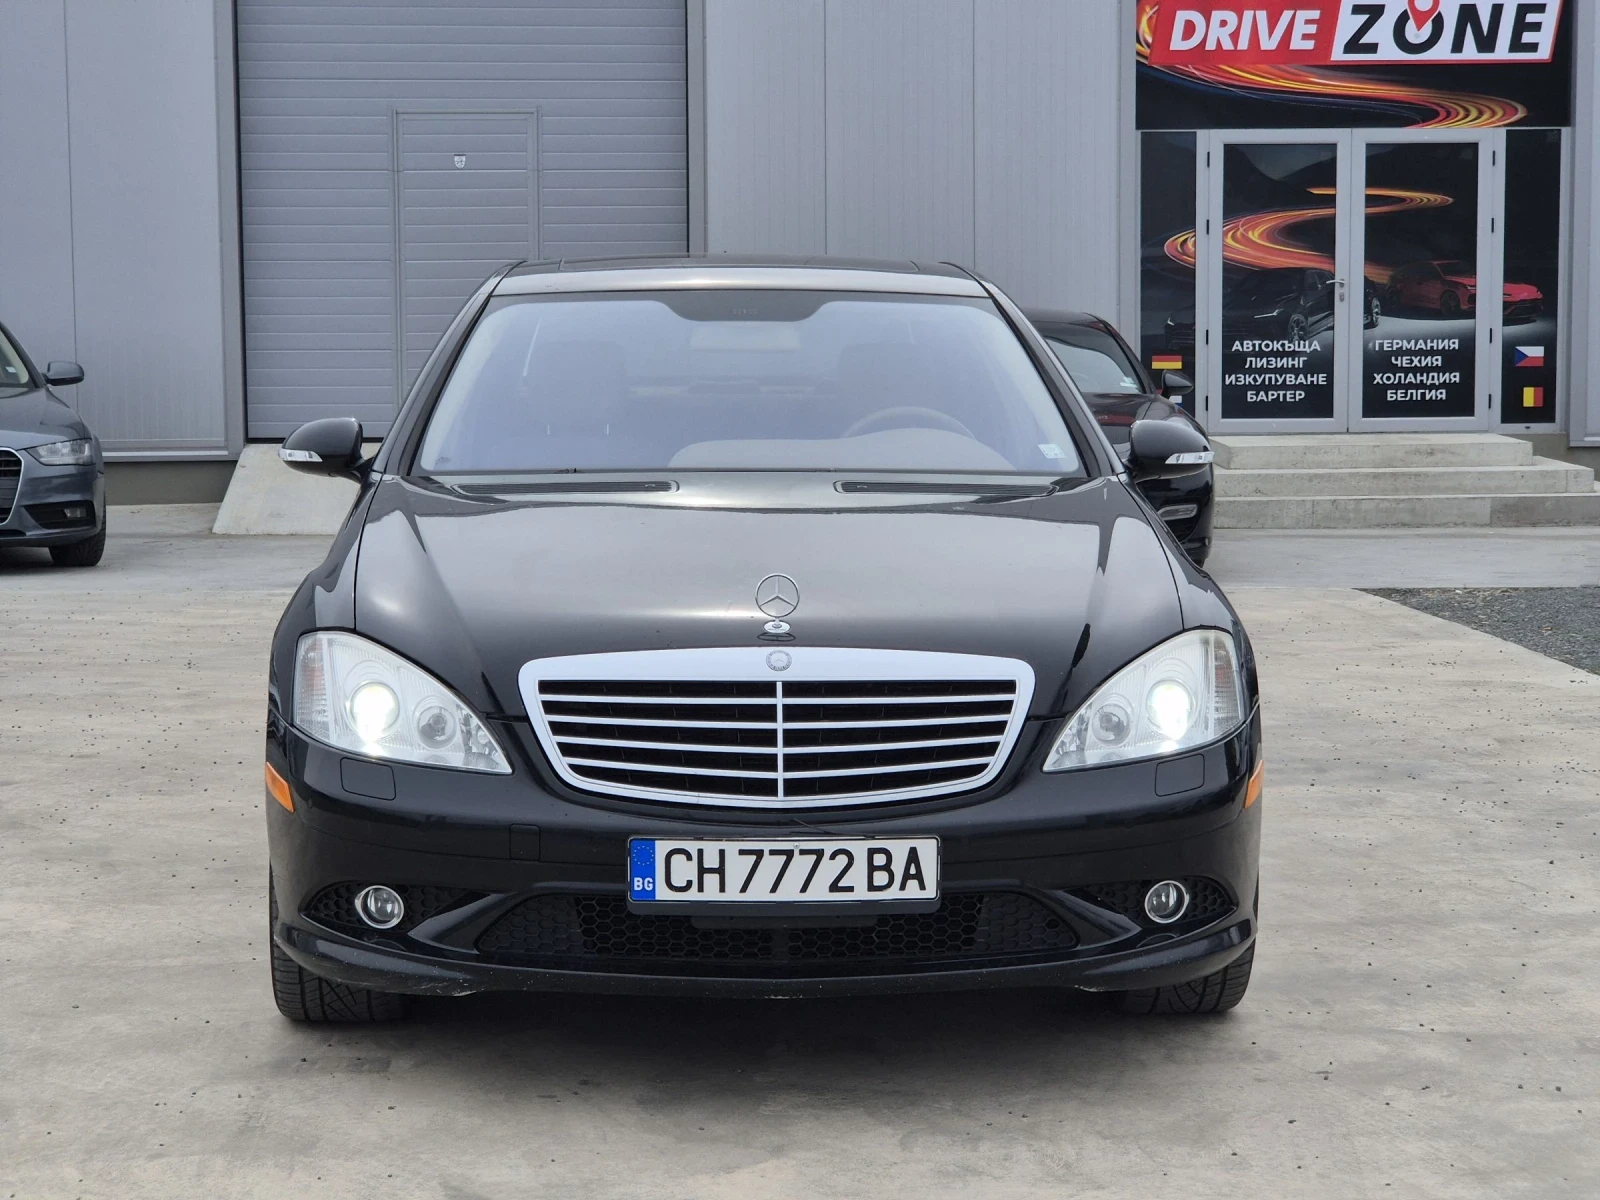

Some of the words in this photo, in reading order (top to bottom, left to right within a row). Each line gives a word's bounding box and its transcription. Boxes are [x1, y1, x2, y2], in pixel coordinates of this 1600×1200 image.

[1169, 10, 1321, 51] DRIVE
[1342, 3, 1547, 54] ZONE
[1231, 340, 1320, 353] АВТОКЪЩА
[1375, 339, 1458, 350] ГЕРМАНИЯ
[1245, 357, 1307, 369] ЛИЗИНГ
[1391, 356, 1442, 367] ЧЕХИЯ
[1225, 374, 1327, 385] ИЗКУПУВАНЕ
[1373, 373, 1460, 385] ХОЛАНДИЯ
[1247, 391, 1305, 402] БАРТЕР
[1387, 390, 1446, 401] БЕЛГИЯ
[634, 877, 653, 891] BG
